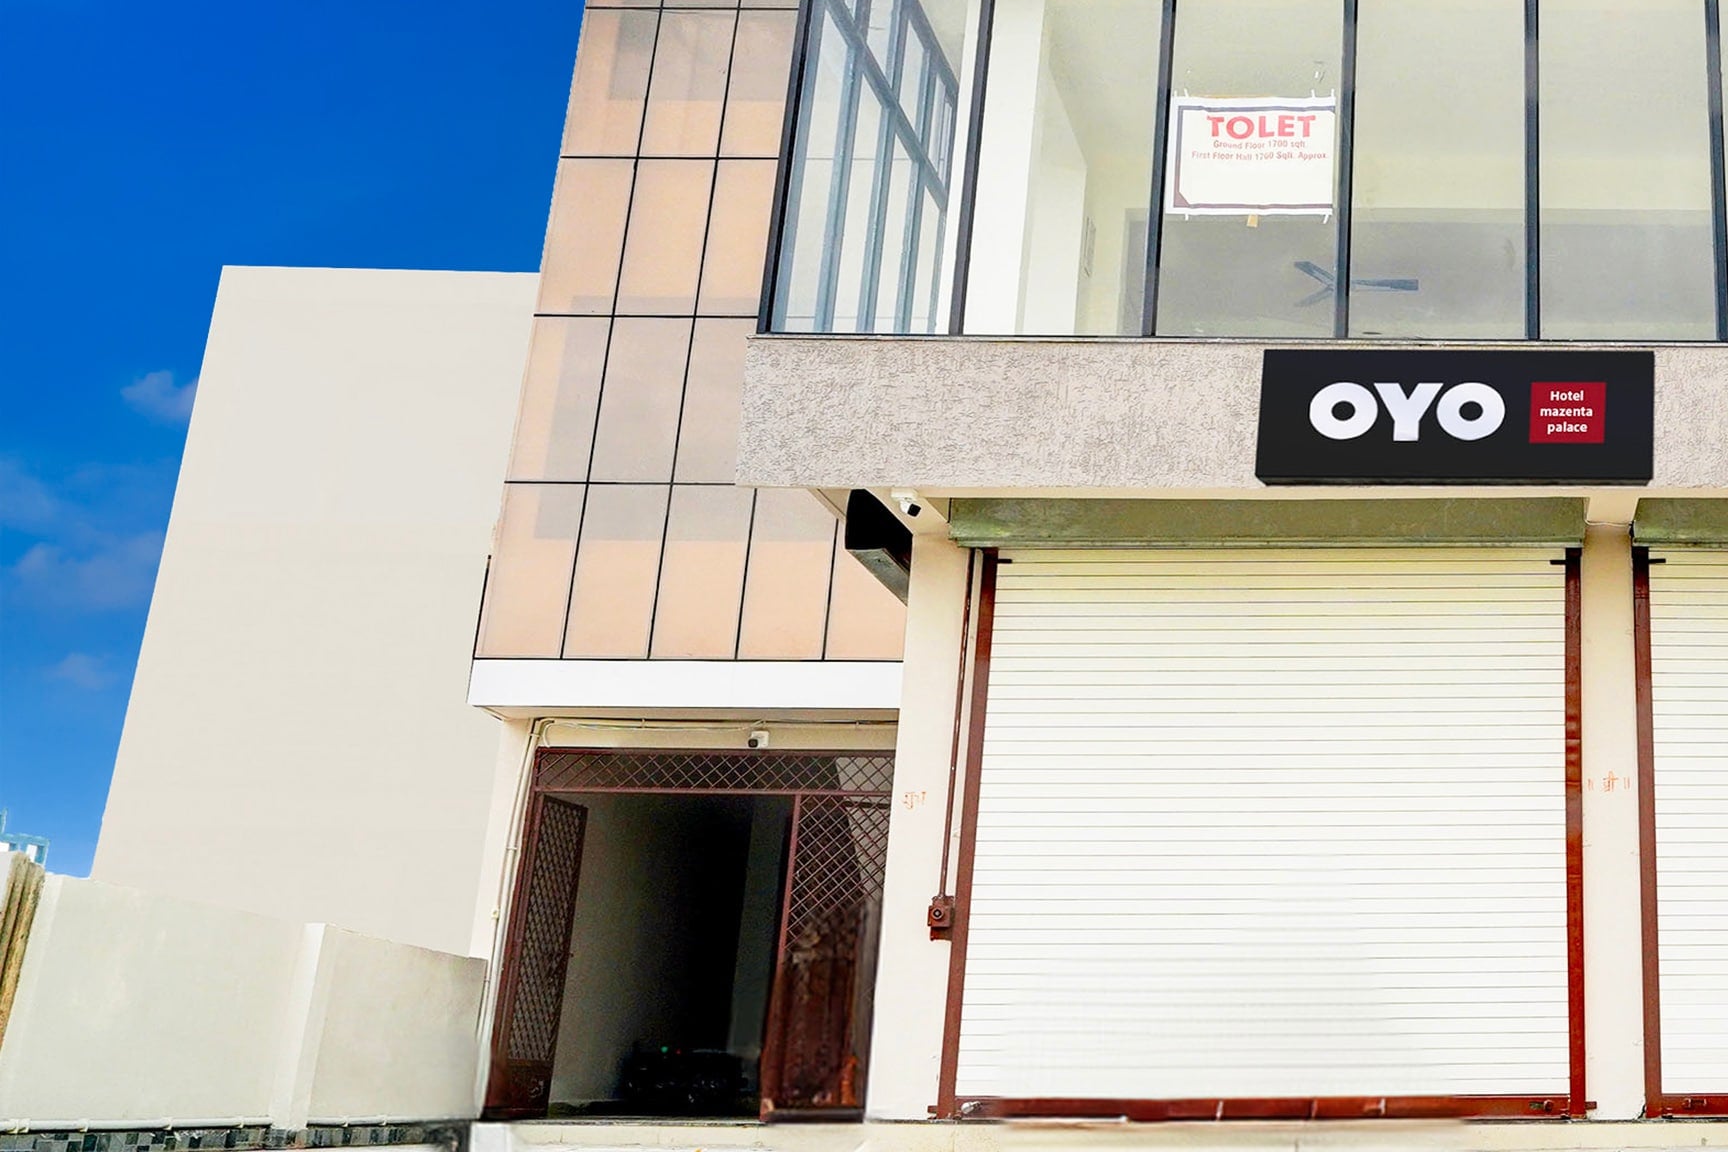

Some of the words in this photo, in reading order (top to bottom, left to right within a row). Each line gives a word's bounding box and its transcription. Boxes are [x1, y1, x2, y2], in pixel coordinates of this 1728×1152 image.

[1206, 115, 1316, 139] TOLET
[1213, 139, 1243, 149] Ground
[1191, 151, 1210, 159] First
[1550, 390, 1584, 401] Hotel
[1309, 381, 1506, 442] OYO
[1540, 407, 1593, 417] mazenta
[1547, 421, 1588, 435] palace
